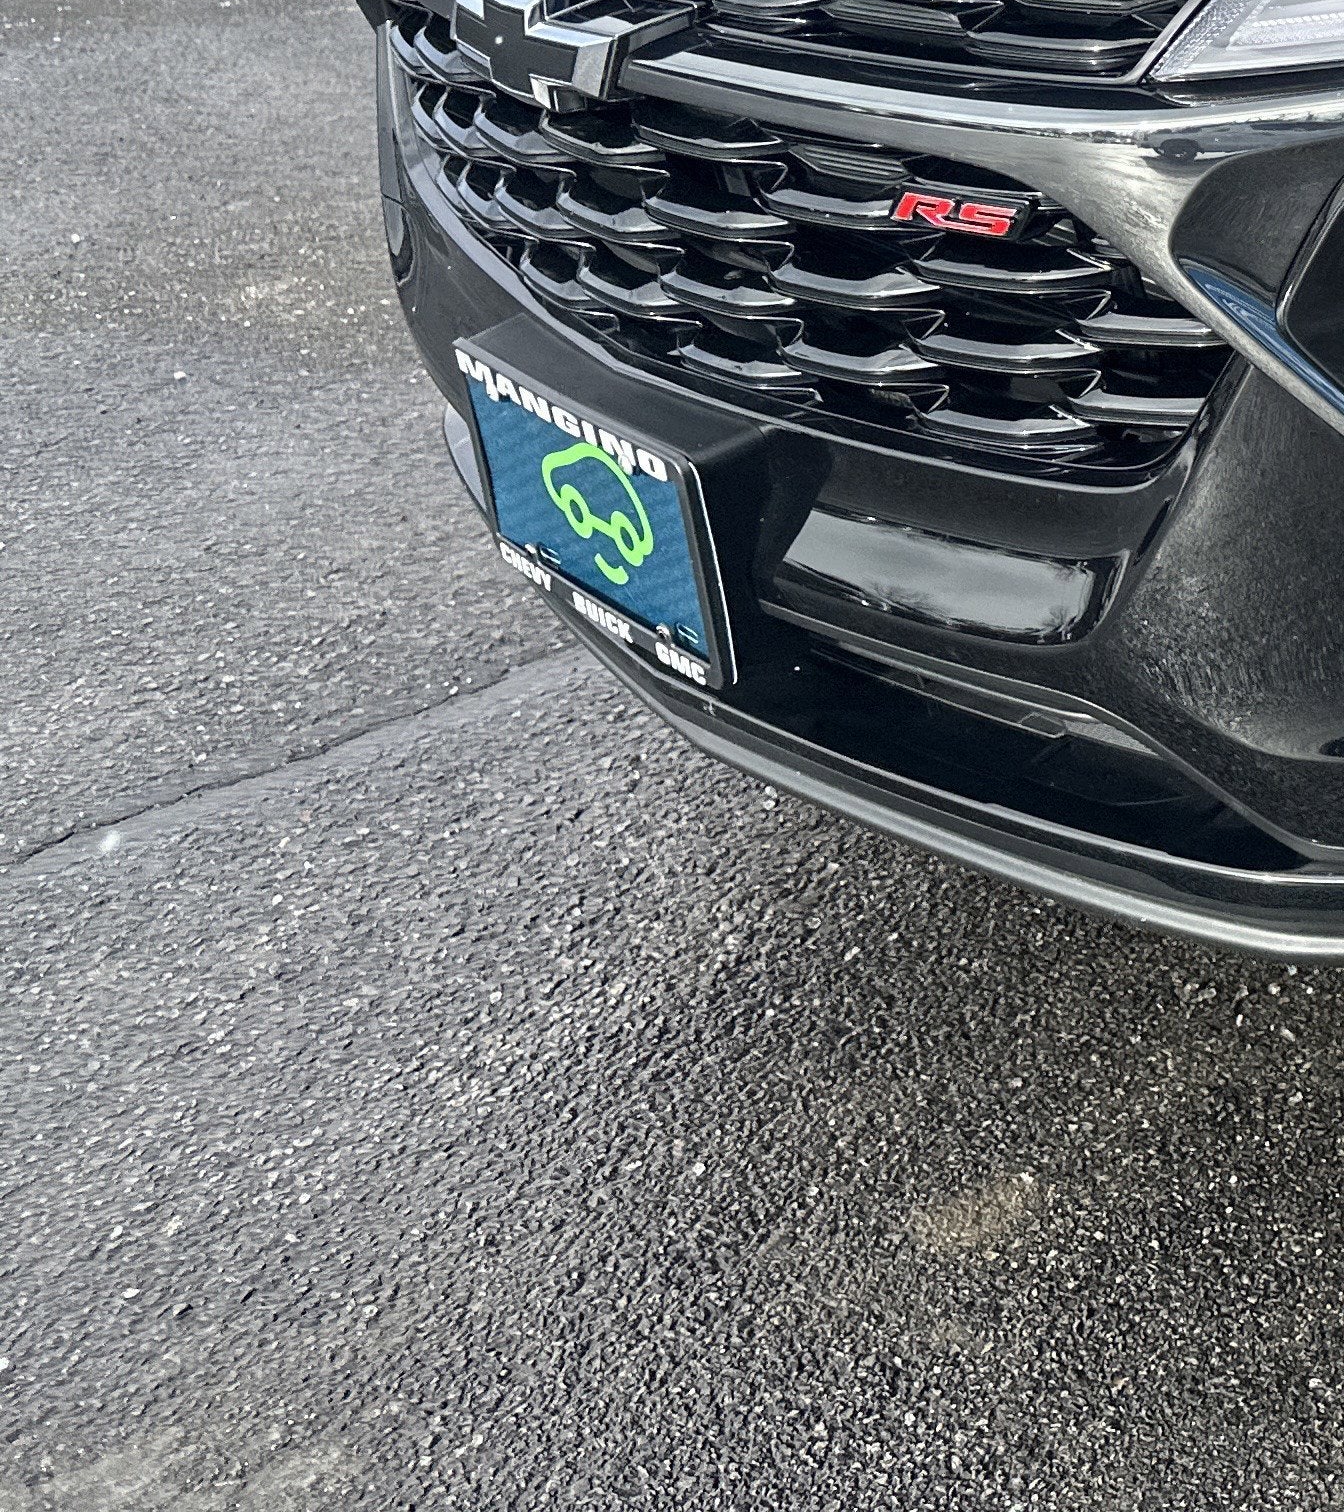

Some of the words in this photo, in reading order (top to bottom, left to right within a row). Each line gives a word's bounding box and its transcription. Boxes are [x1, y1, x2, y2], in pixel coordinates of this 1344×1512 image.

[890, 192, 1018, 236] RS
[454, 348, 669, 482] MANGINO
[499, 541, 553, 592] CHEVY
[572, 591, 634, 643] BUICK
[655, 641, 708, 686] GMC
